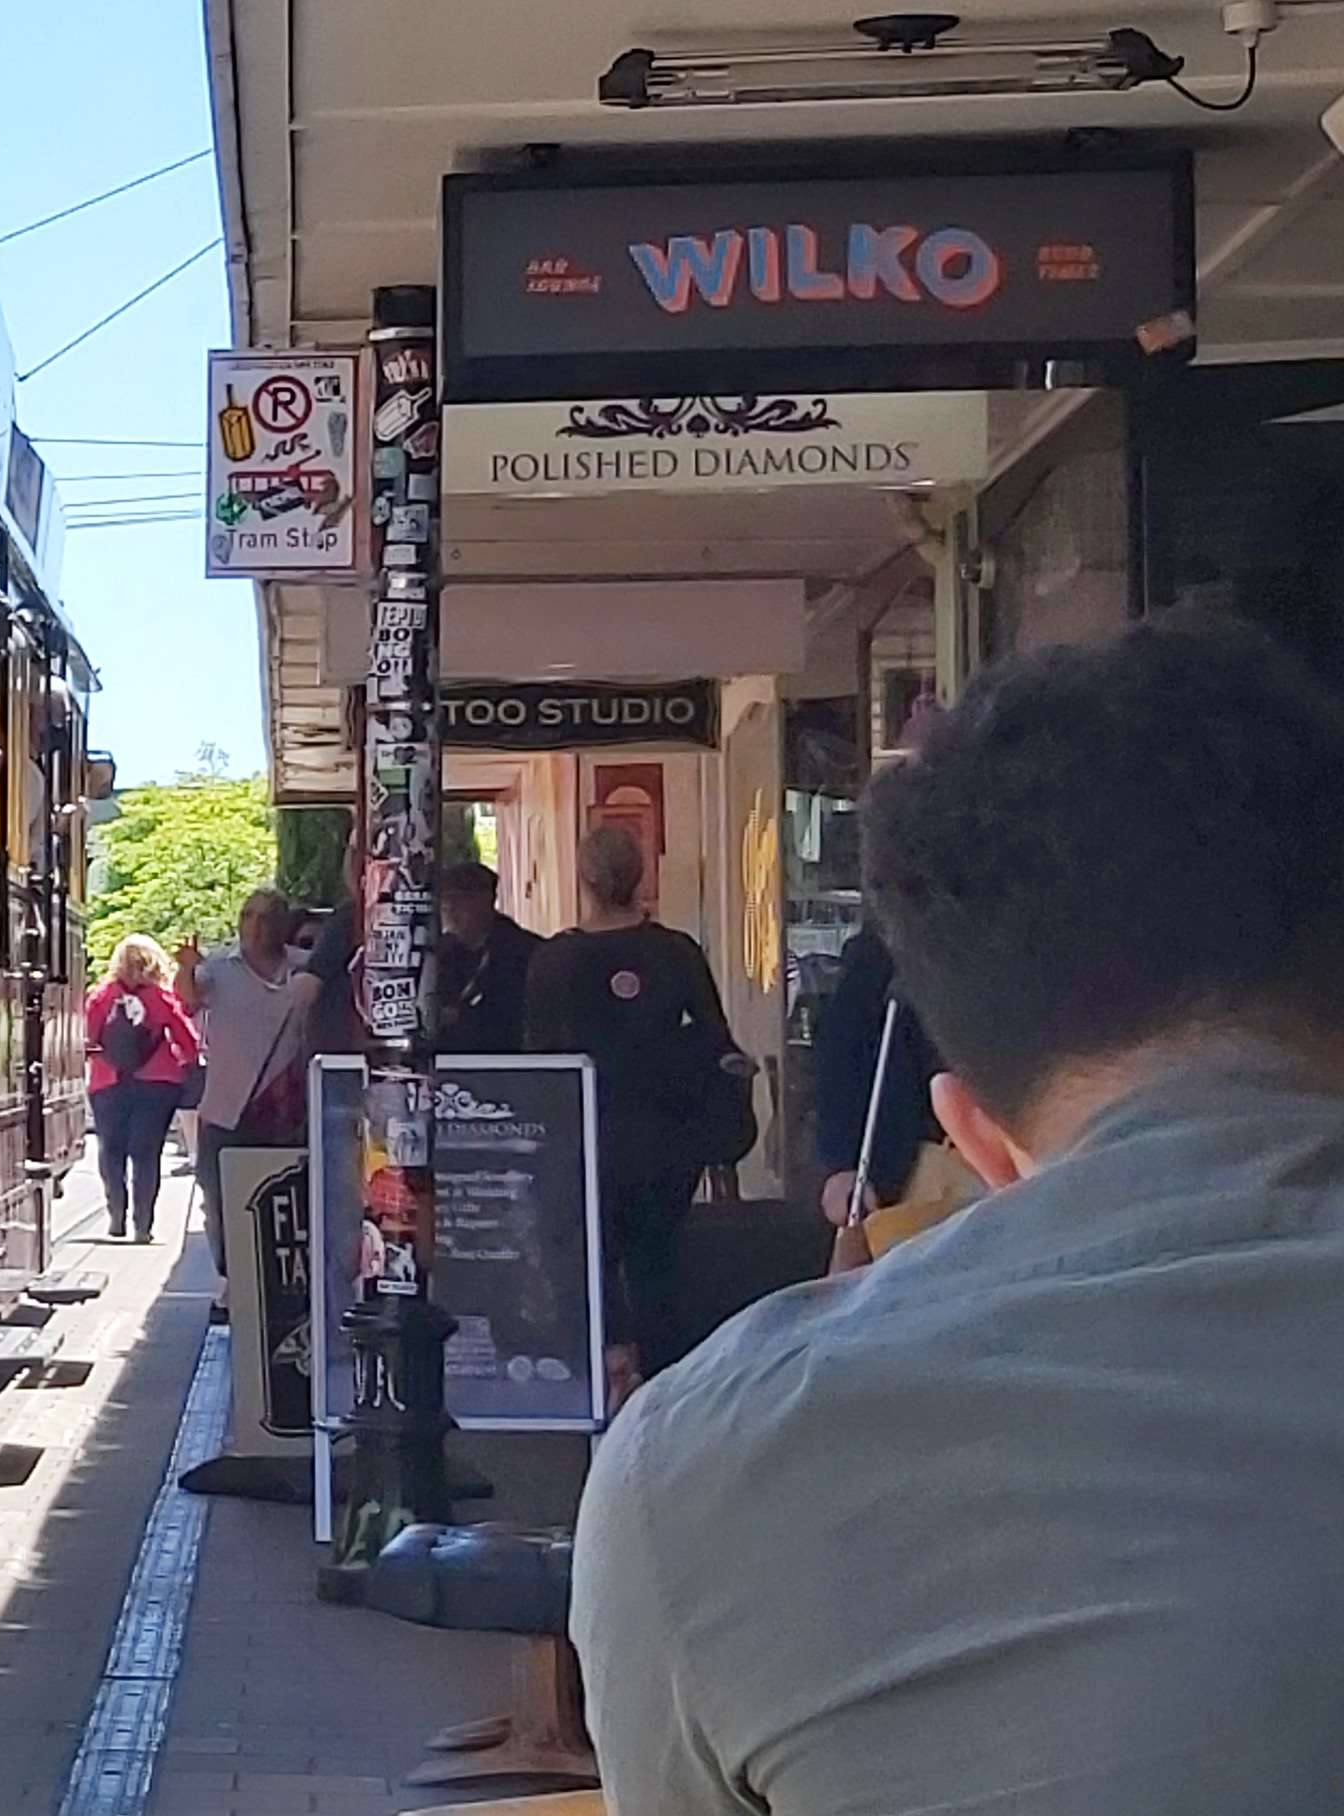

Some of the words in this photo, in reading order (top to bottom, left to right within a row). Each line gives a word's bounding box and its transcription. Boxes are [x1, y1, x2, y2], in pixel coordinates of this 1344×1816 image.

[628, 223, 1000, 313] WILKO
[492, 449, 679, 482] POLISHED
[693, 441, 913, 476] DIAMONDS
[226, 528, 278, 548] Tram
[539, 699, 695, 724] STUDIO
